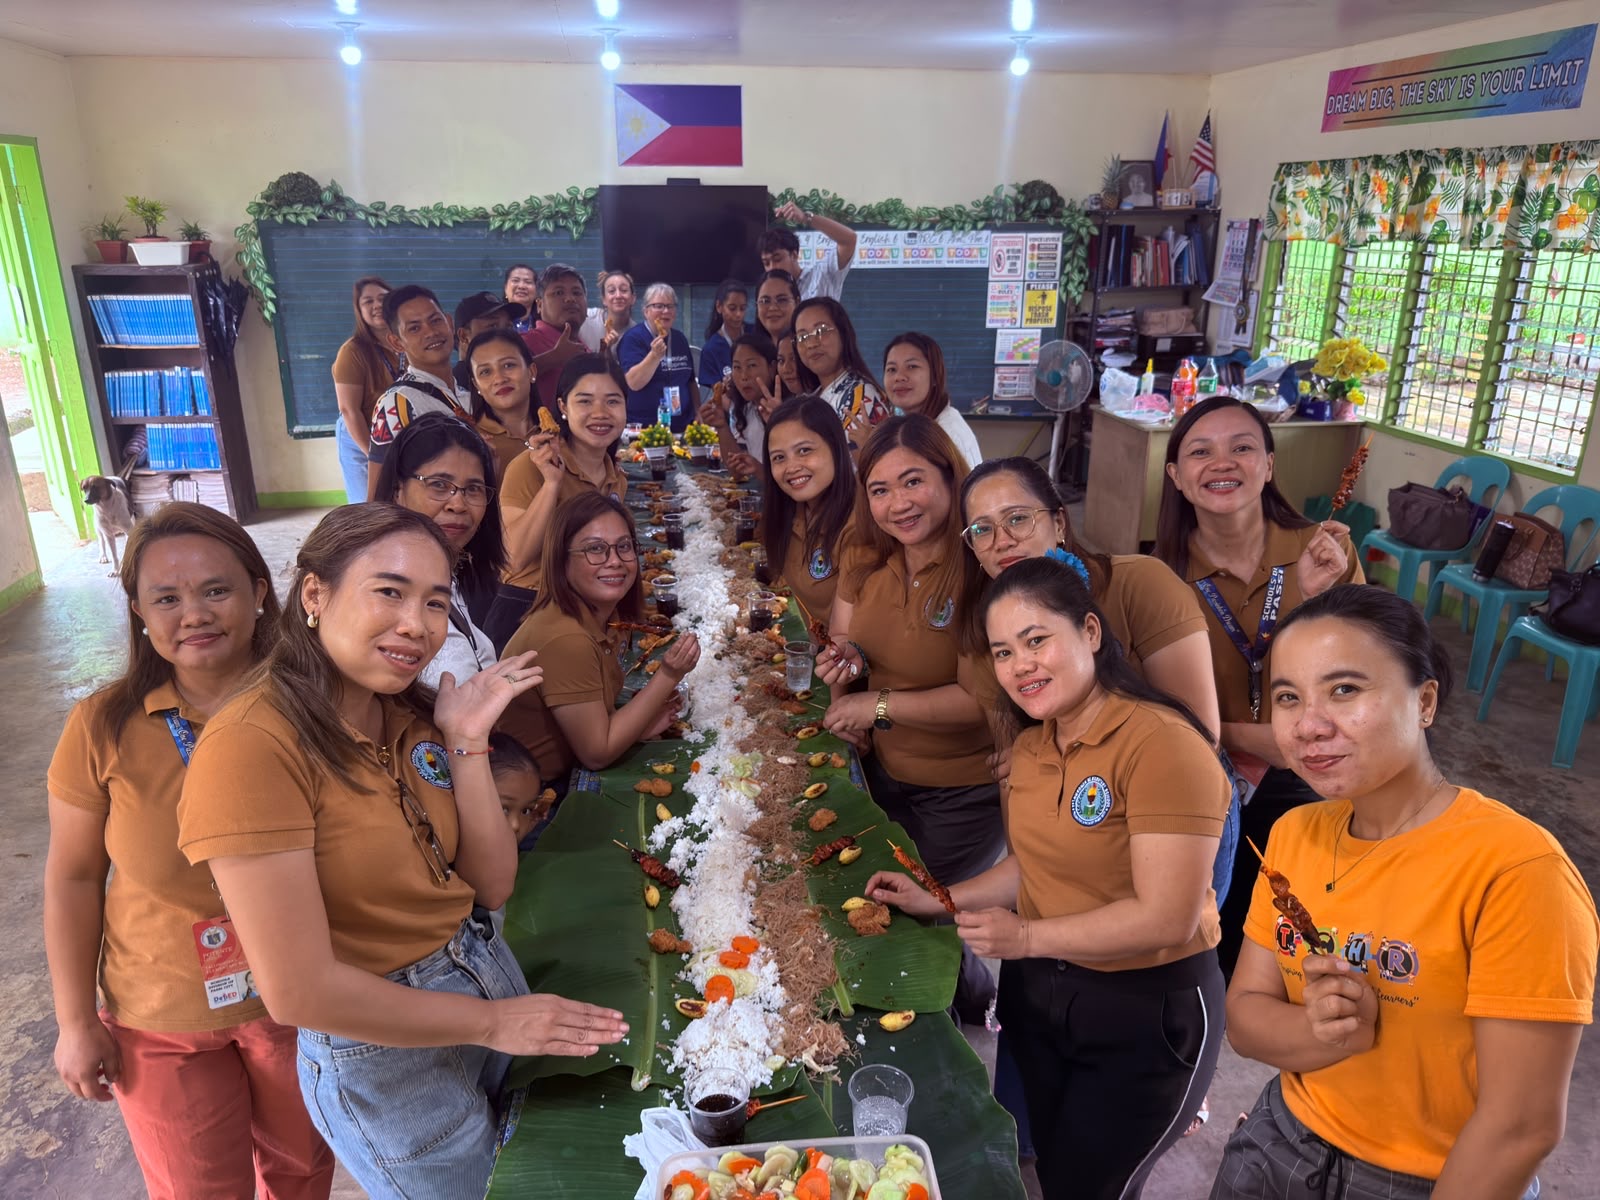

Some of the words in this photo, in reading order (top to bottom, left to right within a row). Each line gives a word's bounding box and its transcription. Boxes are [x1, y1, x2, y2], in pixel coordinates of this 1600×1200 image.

[1326, 91, 1368, 115] DREAM
[1369, 86, 1396, 110] BIG,
[1400, 81, 1426, 106] THE
[1427, 76, 1458, 104] SKY
[1458, 73, 1477, 99] IS
[1480, 67, 1526, 97] YOUR
[1529, 58, 1584, 91] LIMIT
[860, 233, 890, 246] English
[859, 248, 900, 259] TODAY
[904, 248, 944, 259] TODAY
[948, 248, 988, 259] TODAY
[1262, 578, 1277, 621] SCHOOLS
[1270, 569, 1284, 621] PASSI
